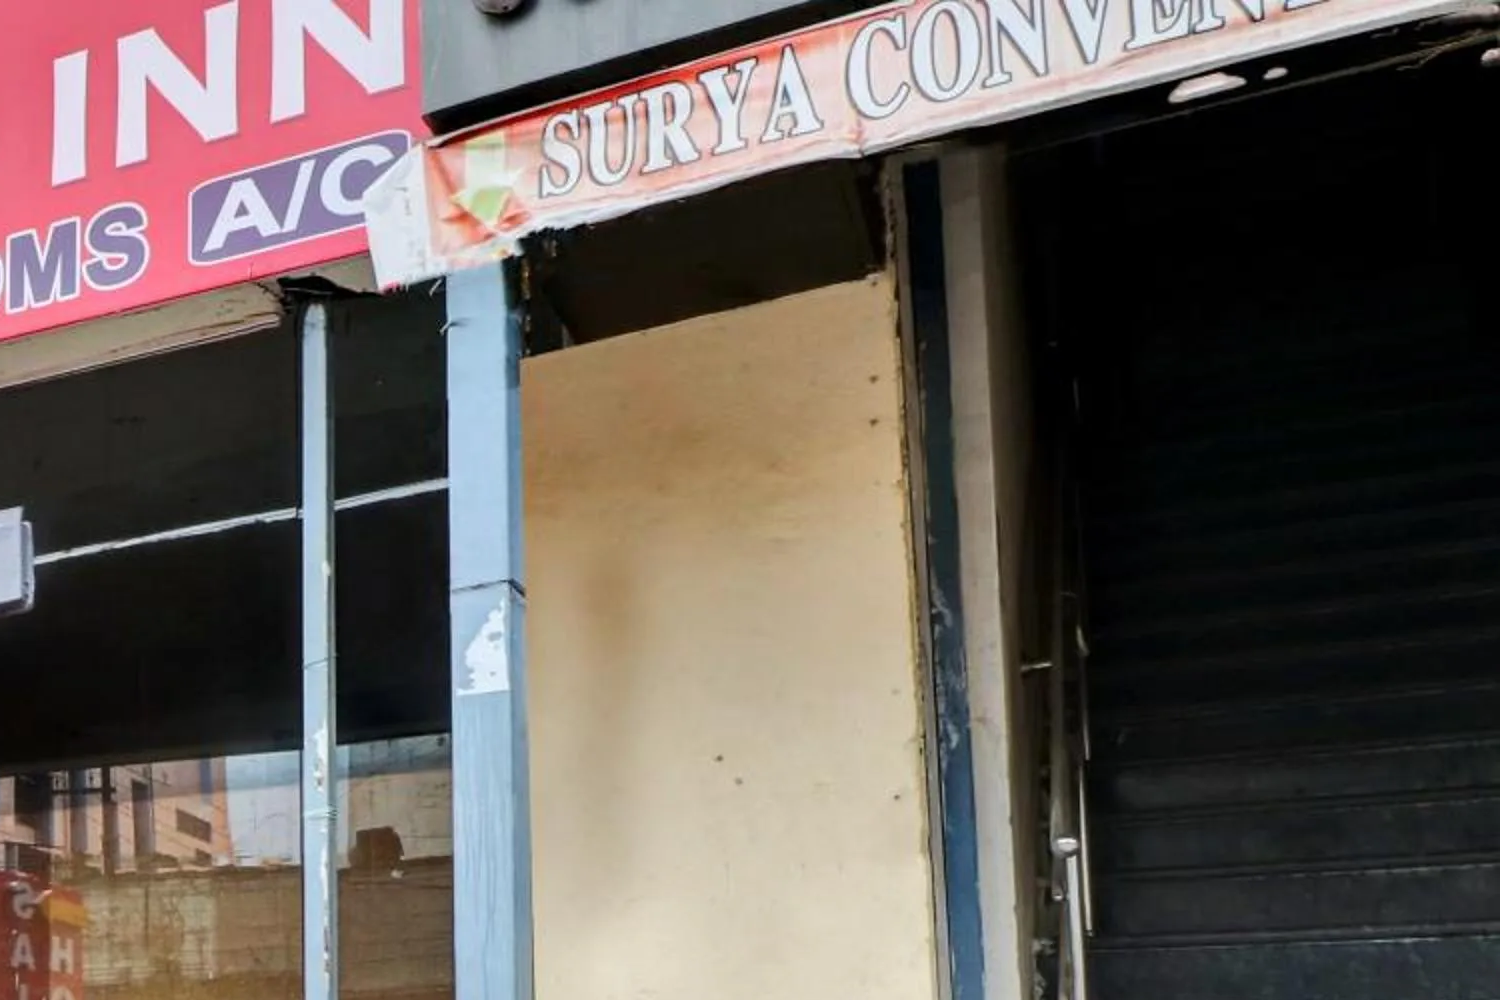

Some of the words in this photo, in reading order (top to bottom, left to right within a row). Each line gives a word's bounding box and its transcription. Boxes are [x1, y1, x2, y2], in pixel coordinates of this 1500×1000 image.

[50, 0, 406, 188] INN
[539, 44, 822, 200] SURYA
[202, 143, 396, 254] A/C
